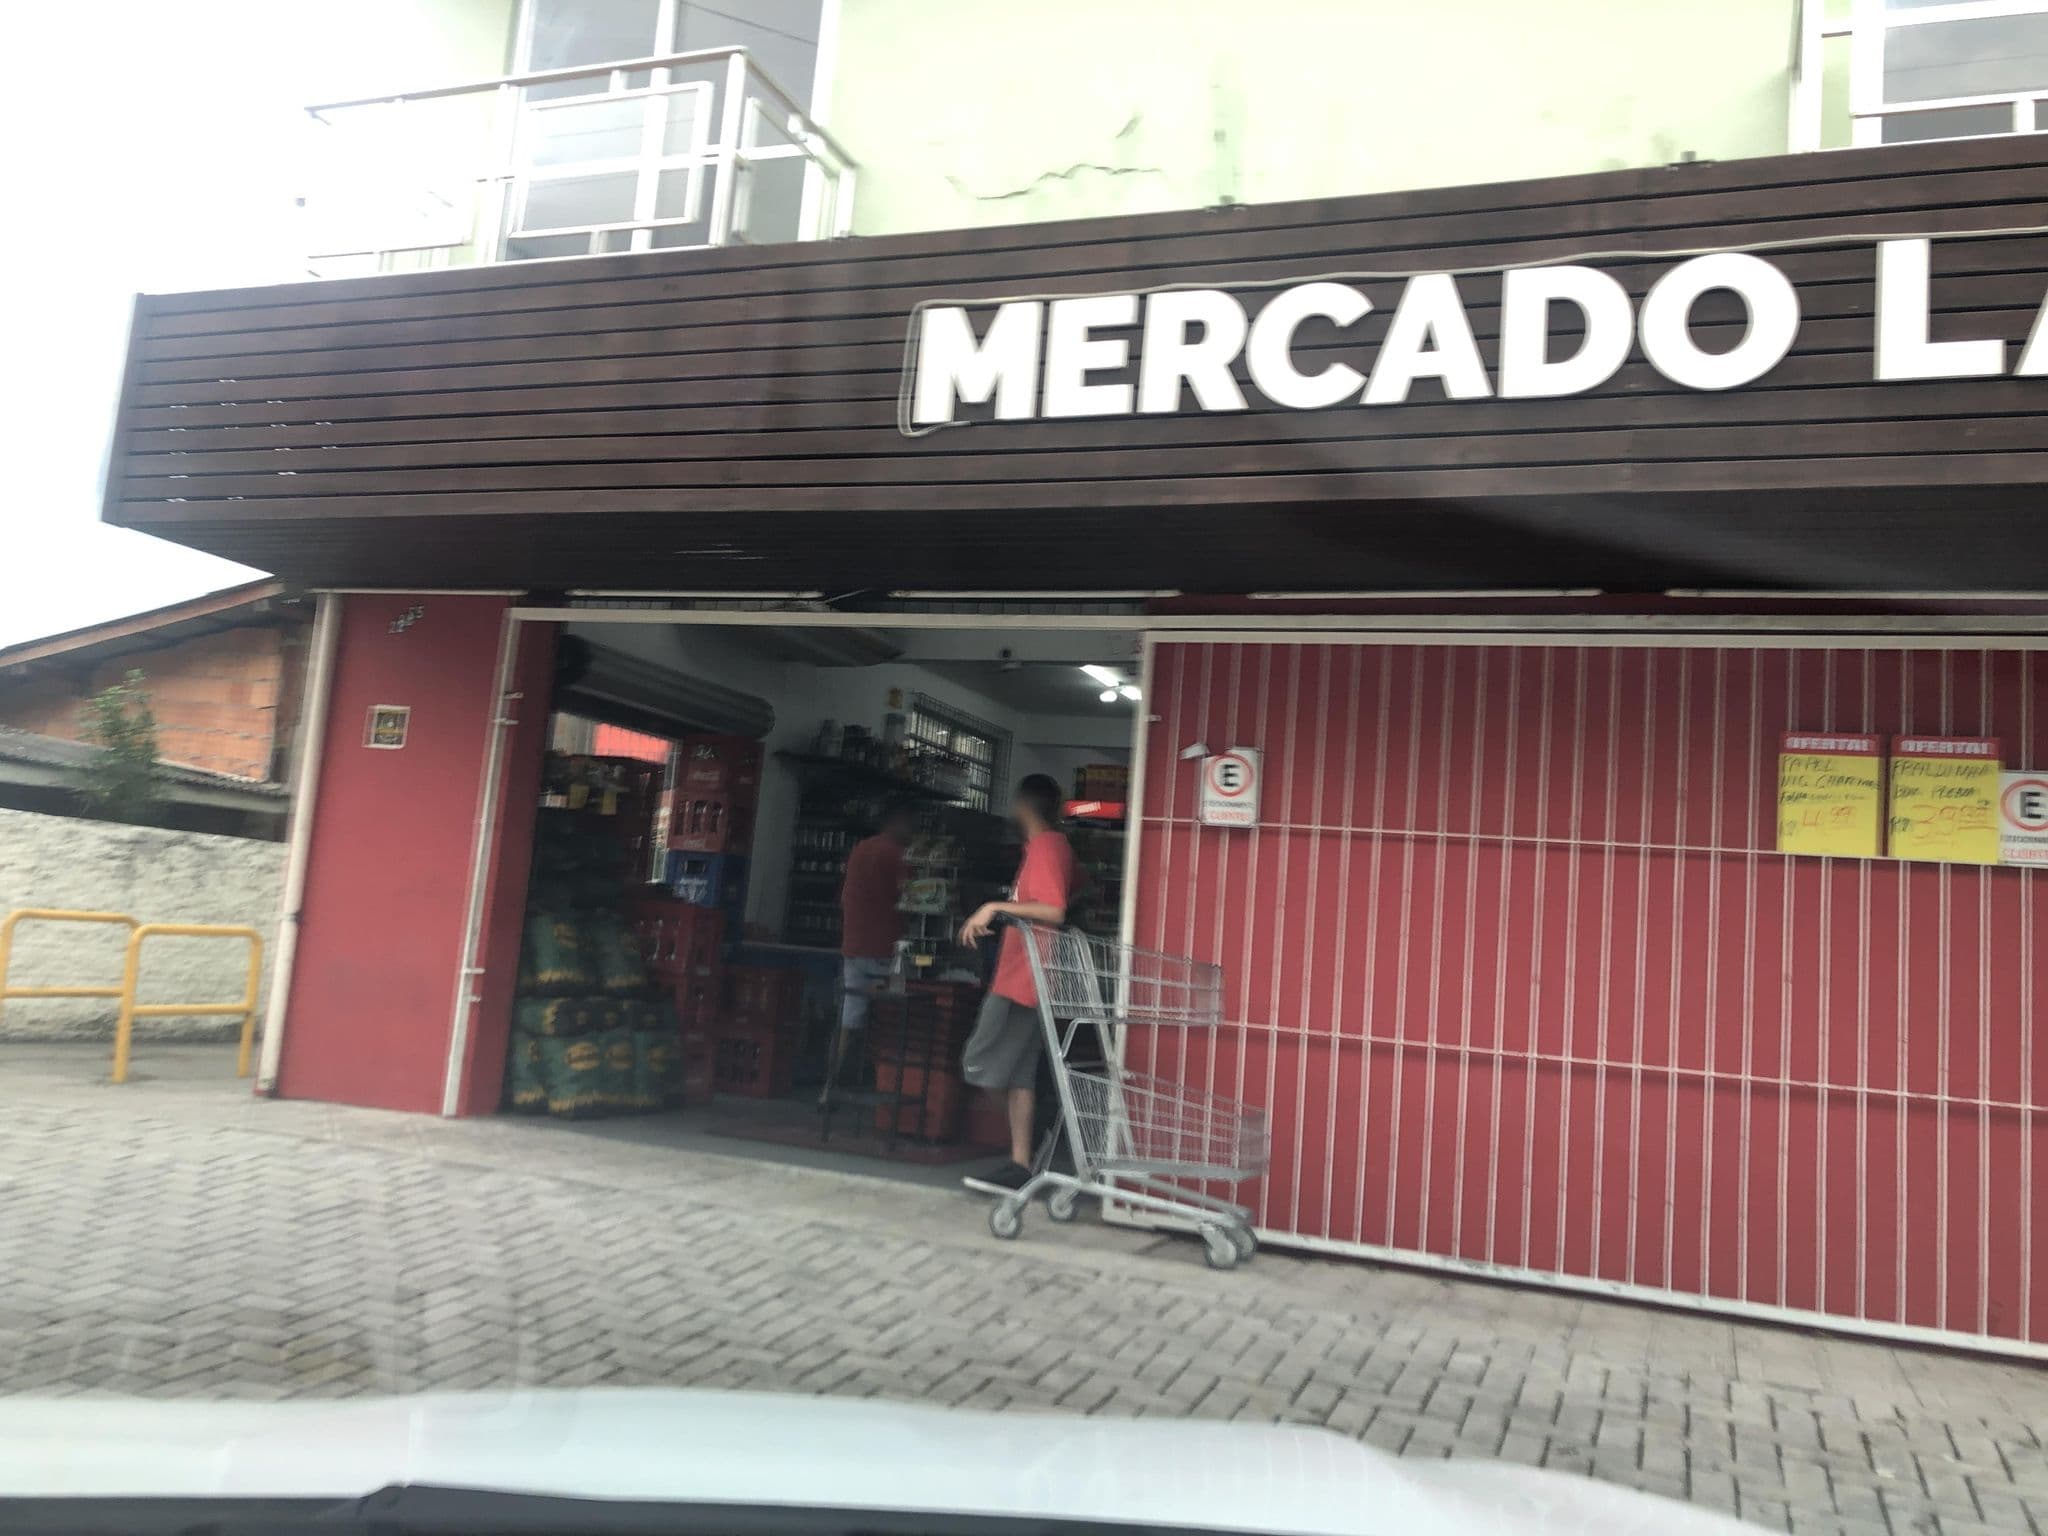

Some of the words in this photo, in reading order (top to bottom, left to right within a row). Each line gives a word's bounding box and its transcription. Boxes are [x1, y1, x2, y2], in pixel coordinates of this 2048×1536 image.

[912, 253, 1802, 423] MERCADO
[1220, 764, 1239, 787] E
[2020, 791, 2045, 819] E
